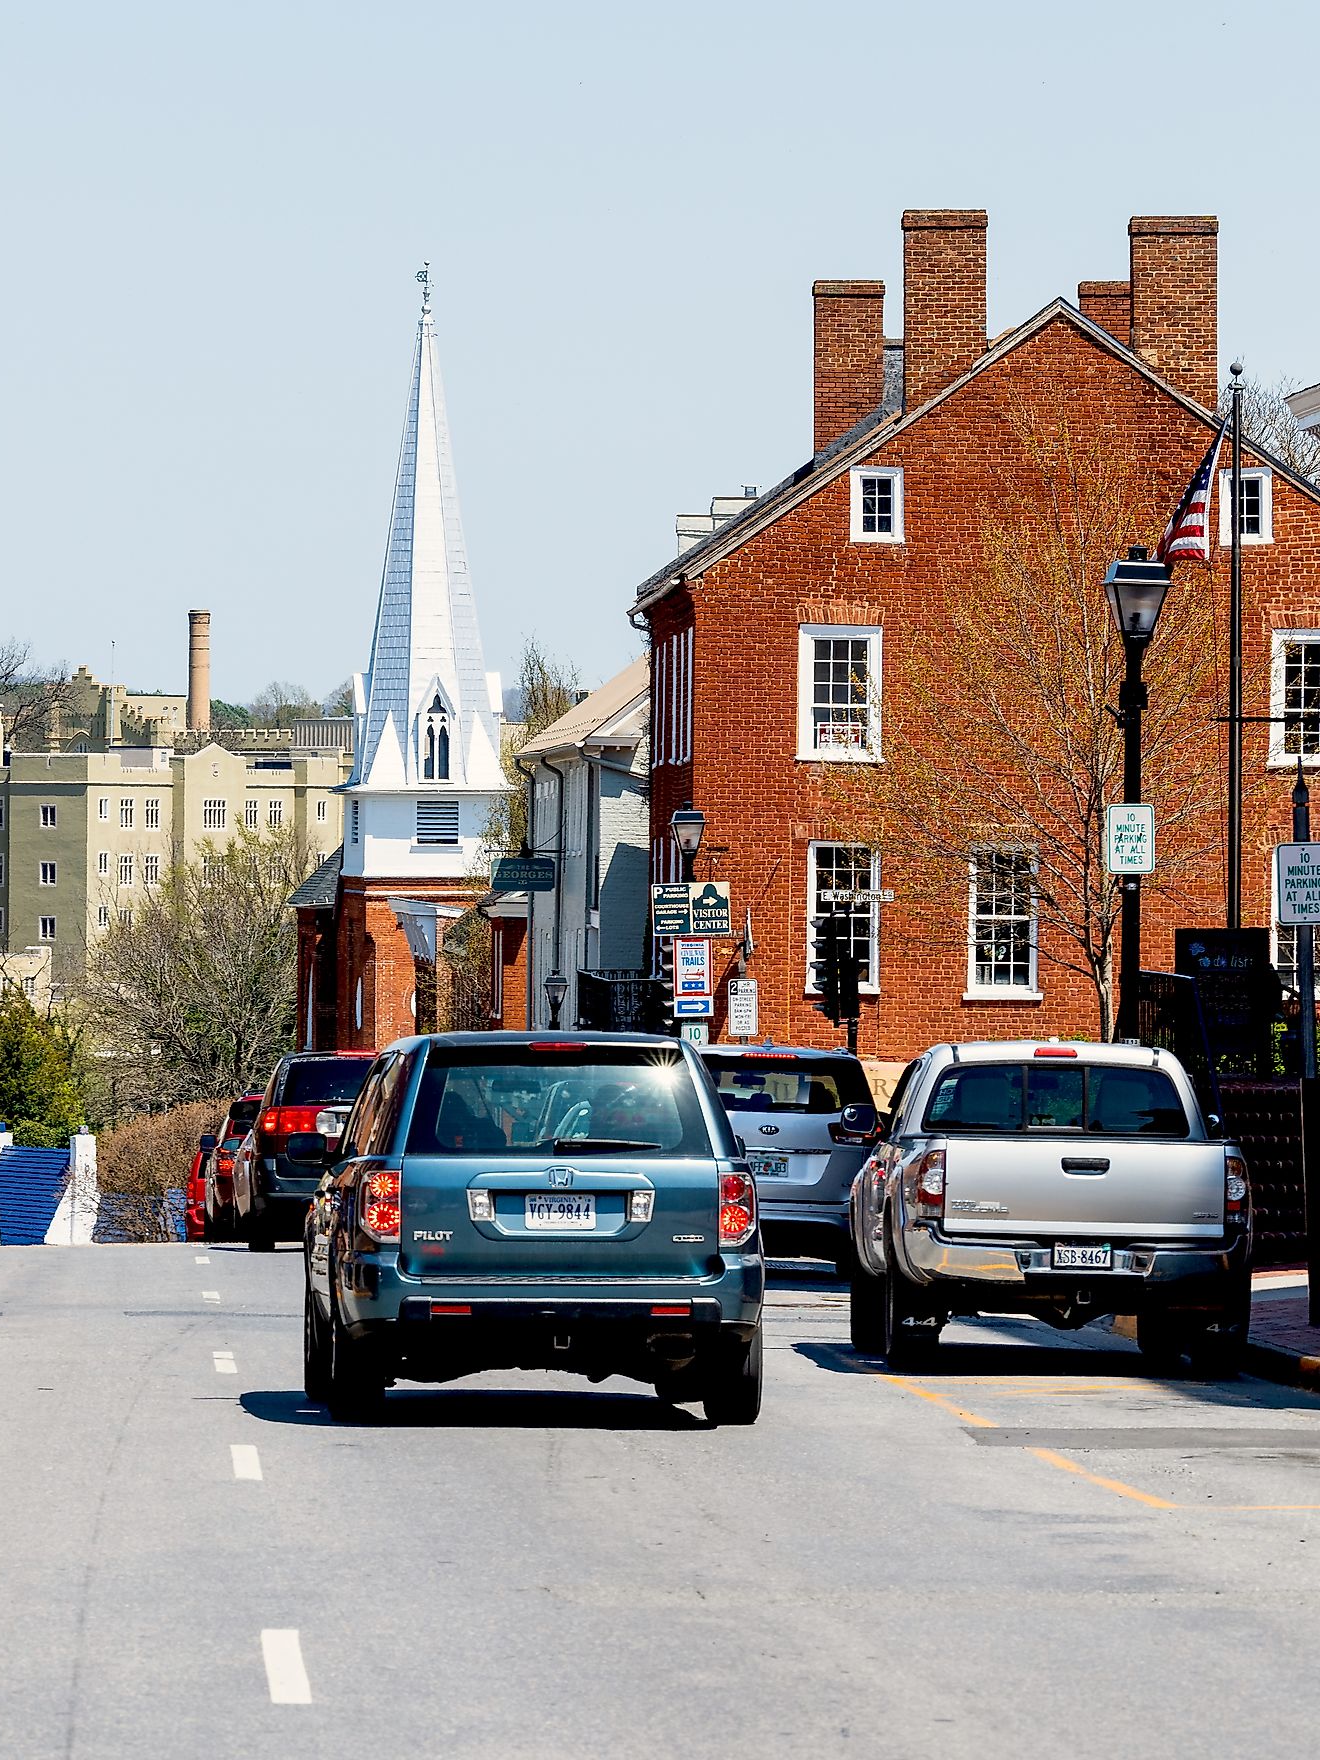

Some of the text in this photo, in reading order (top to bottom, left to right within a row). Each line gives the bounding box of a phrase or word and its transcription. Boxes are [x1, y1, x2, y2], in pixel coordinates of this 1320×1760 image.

[1127, 812, 1136, 822] 10
[1115, 823, 1146, 833] MINUTE
[1114, 834, 1148, 844] PARKING
[1114, 845, 1146, 854] AT ALL
[1120, 855, 1144, 865] TIMES
[1300, 852, 1311, 864] 10
[496, 870, 554, 879] GEORGES
[654, 886, 664, 899] P
[822, 891, 828, 900] E
[1285, 890, 1297, 902] AT
[693, 908, 729, 918] VISITOR
[1291, 902, 1320, 914] TIMES
[693, 920, 729, 930] CENTER
[681, 957, 705, 966] TRAILS
[730, 981, 738, 994] 2
[688, 1027, 701, 1041] 10
[529, 1203, 591, 1220] VGY-9844
[413, 1230, 454, 1241] PILOT
